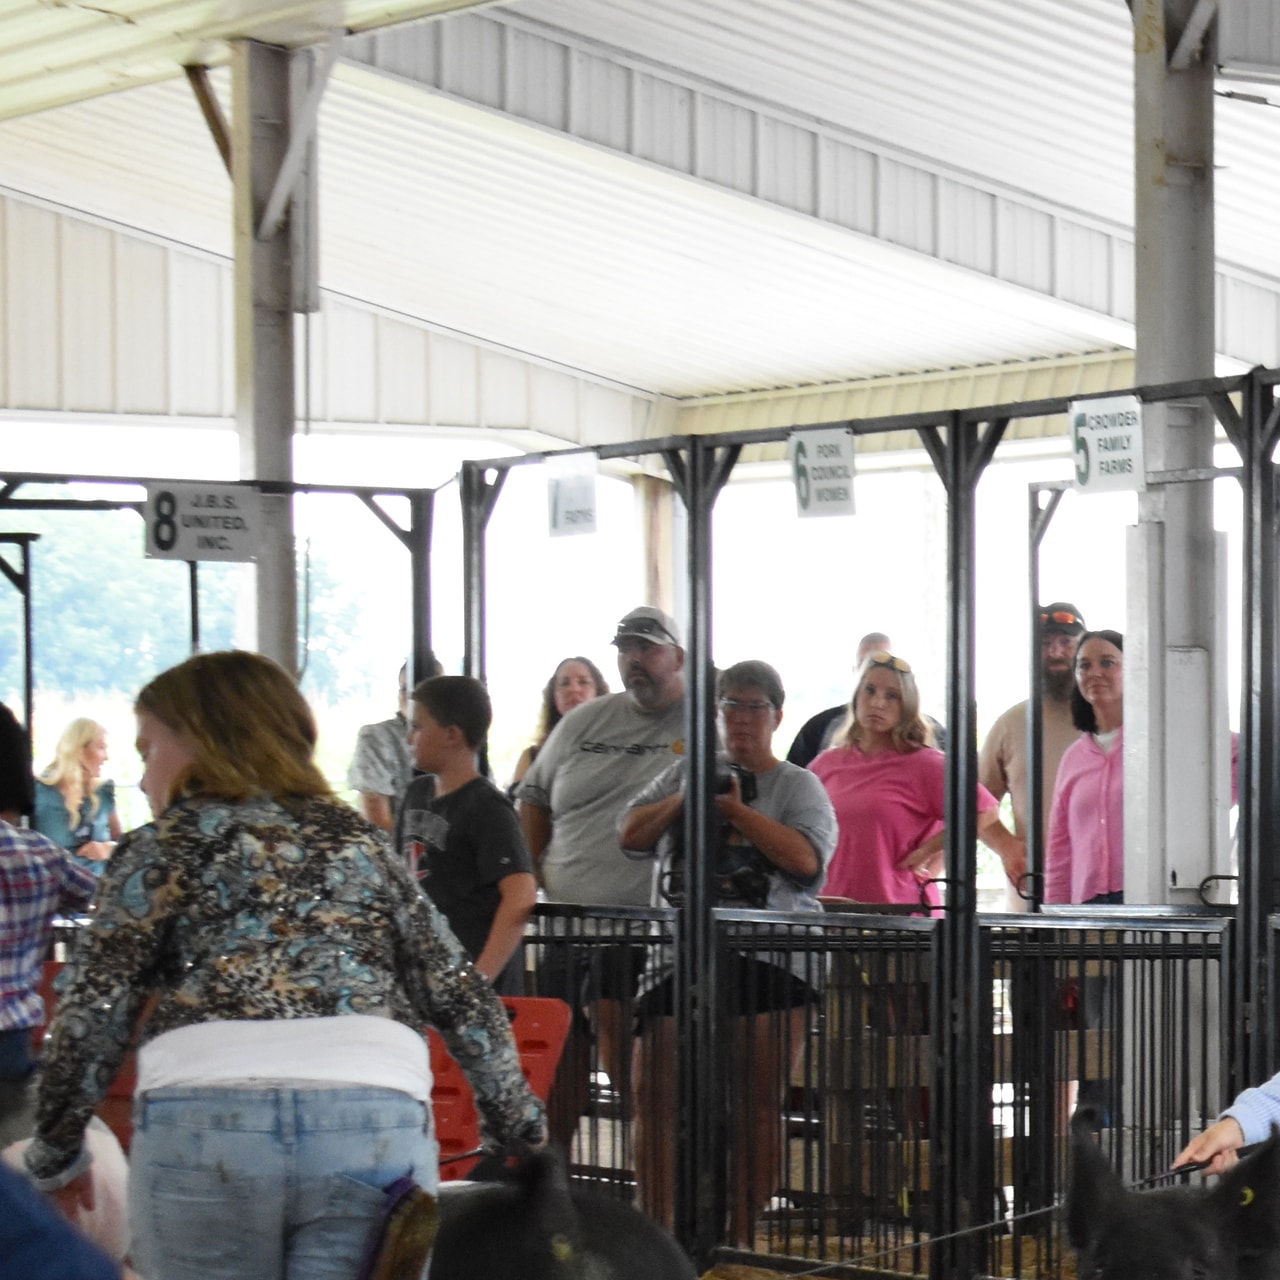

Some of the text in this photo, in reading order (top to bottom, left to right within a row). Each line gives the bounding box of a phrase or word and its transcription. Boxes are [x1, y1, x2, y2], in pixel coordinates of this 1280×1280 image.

[1087, 411, 1137, 430] CROWDER
[1074, 413, 1090, 486] 5
[1097, 435, 1131, 453] FAMILY
[795, 440, 810, 511] 6
[1098, 458, 1133, 475] FARMS
[153, 491, 177, 551] 8
